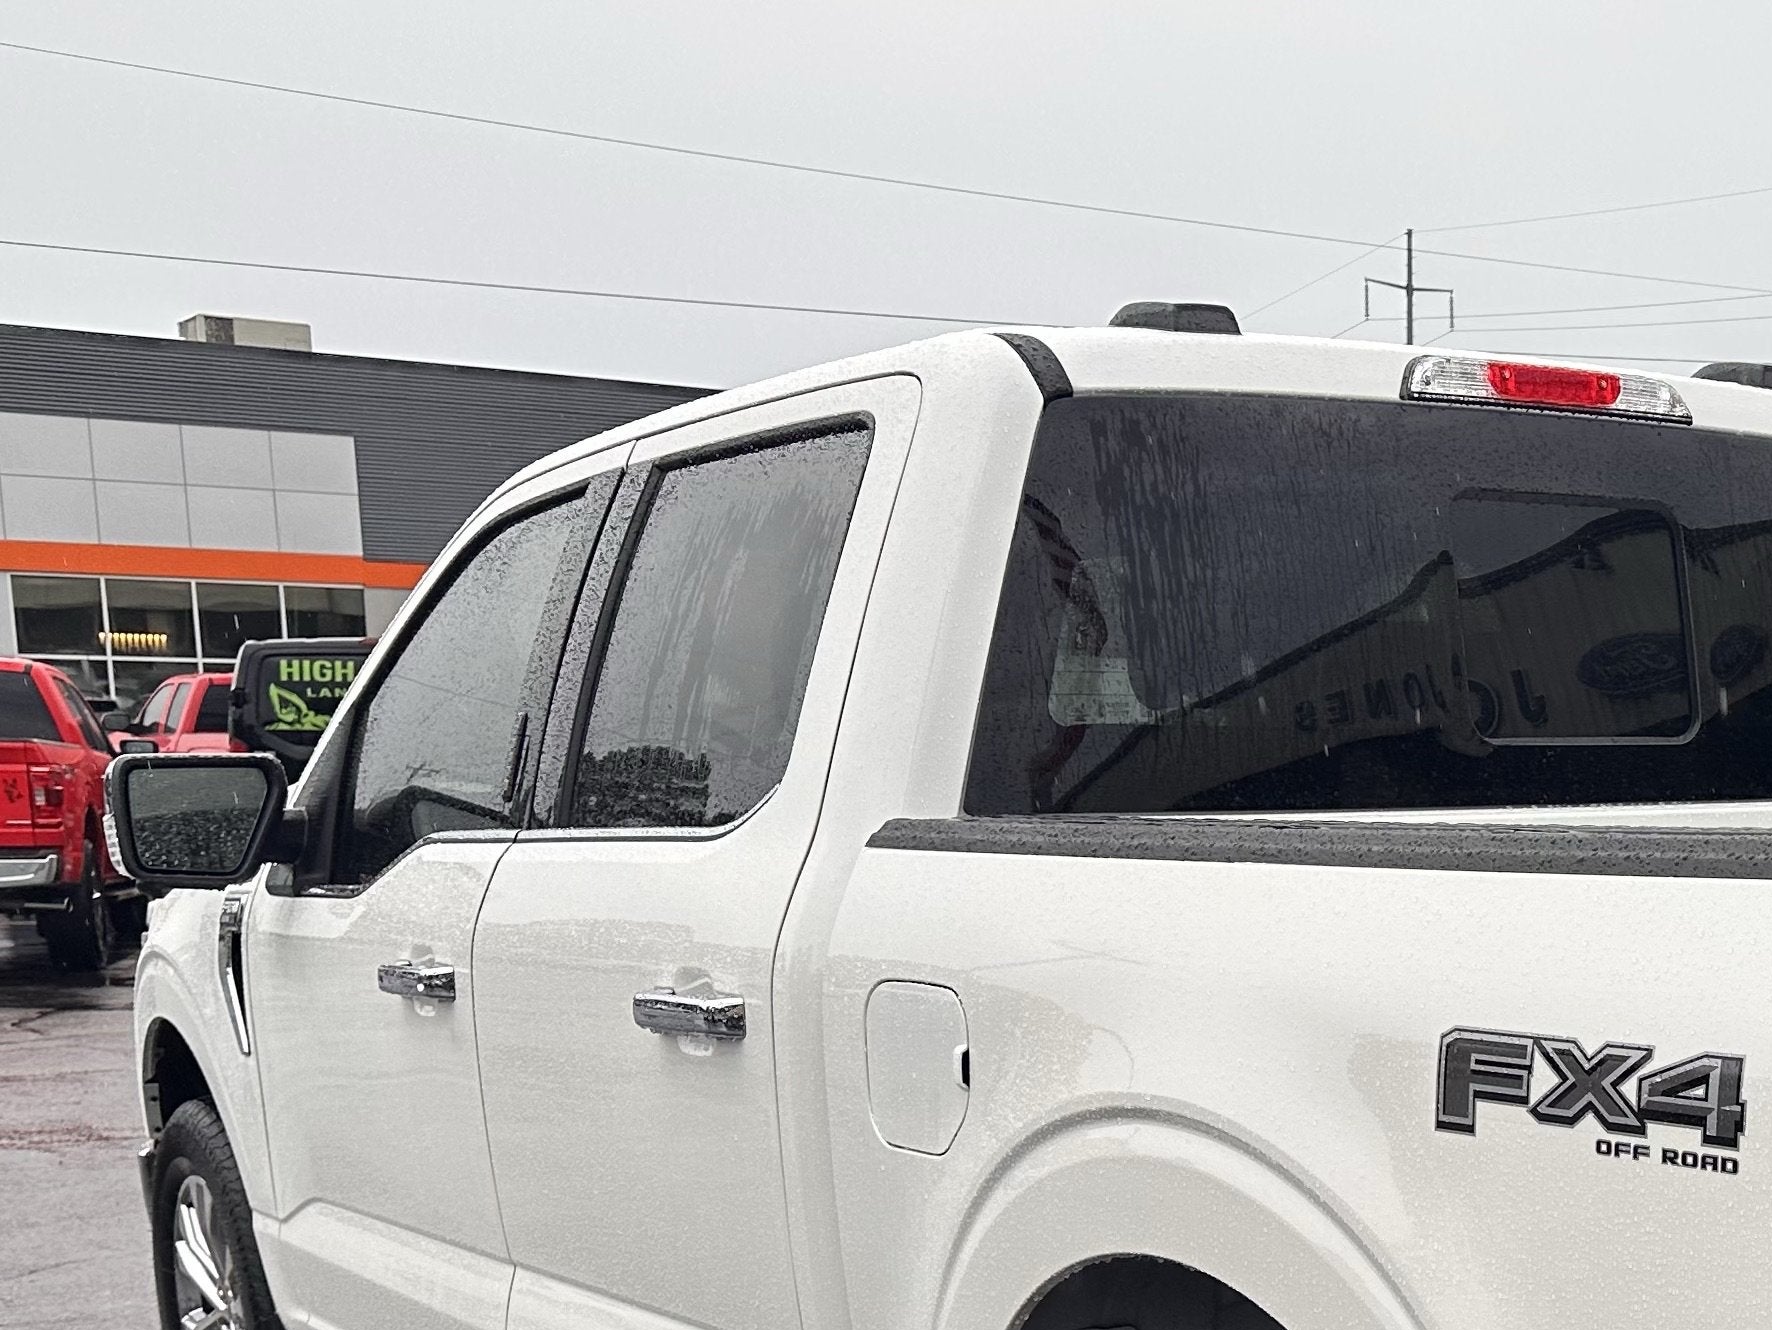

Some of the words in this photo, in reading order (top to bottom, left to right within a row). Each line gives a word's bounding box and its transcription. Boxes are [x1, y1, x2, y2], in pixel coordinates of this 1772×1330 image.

[280, 659, 355, 682] HIGH
[1434, 1025, 1748, 1152] FX4
[1595, 1138, 1650, 1161] OFF
[1661, 1147, 1740, 1175] ROAD
